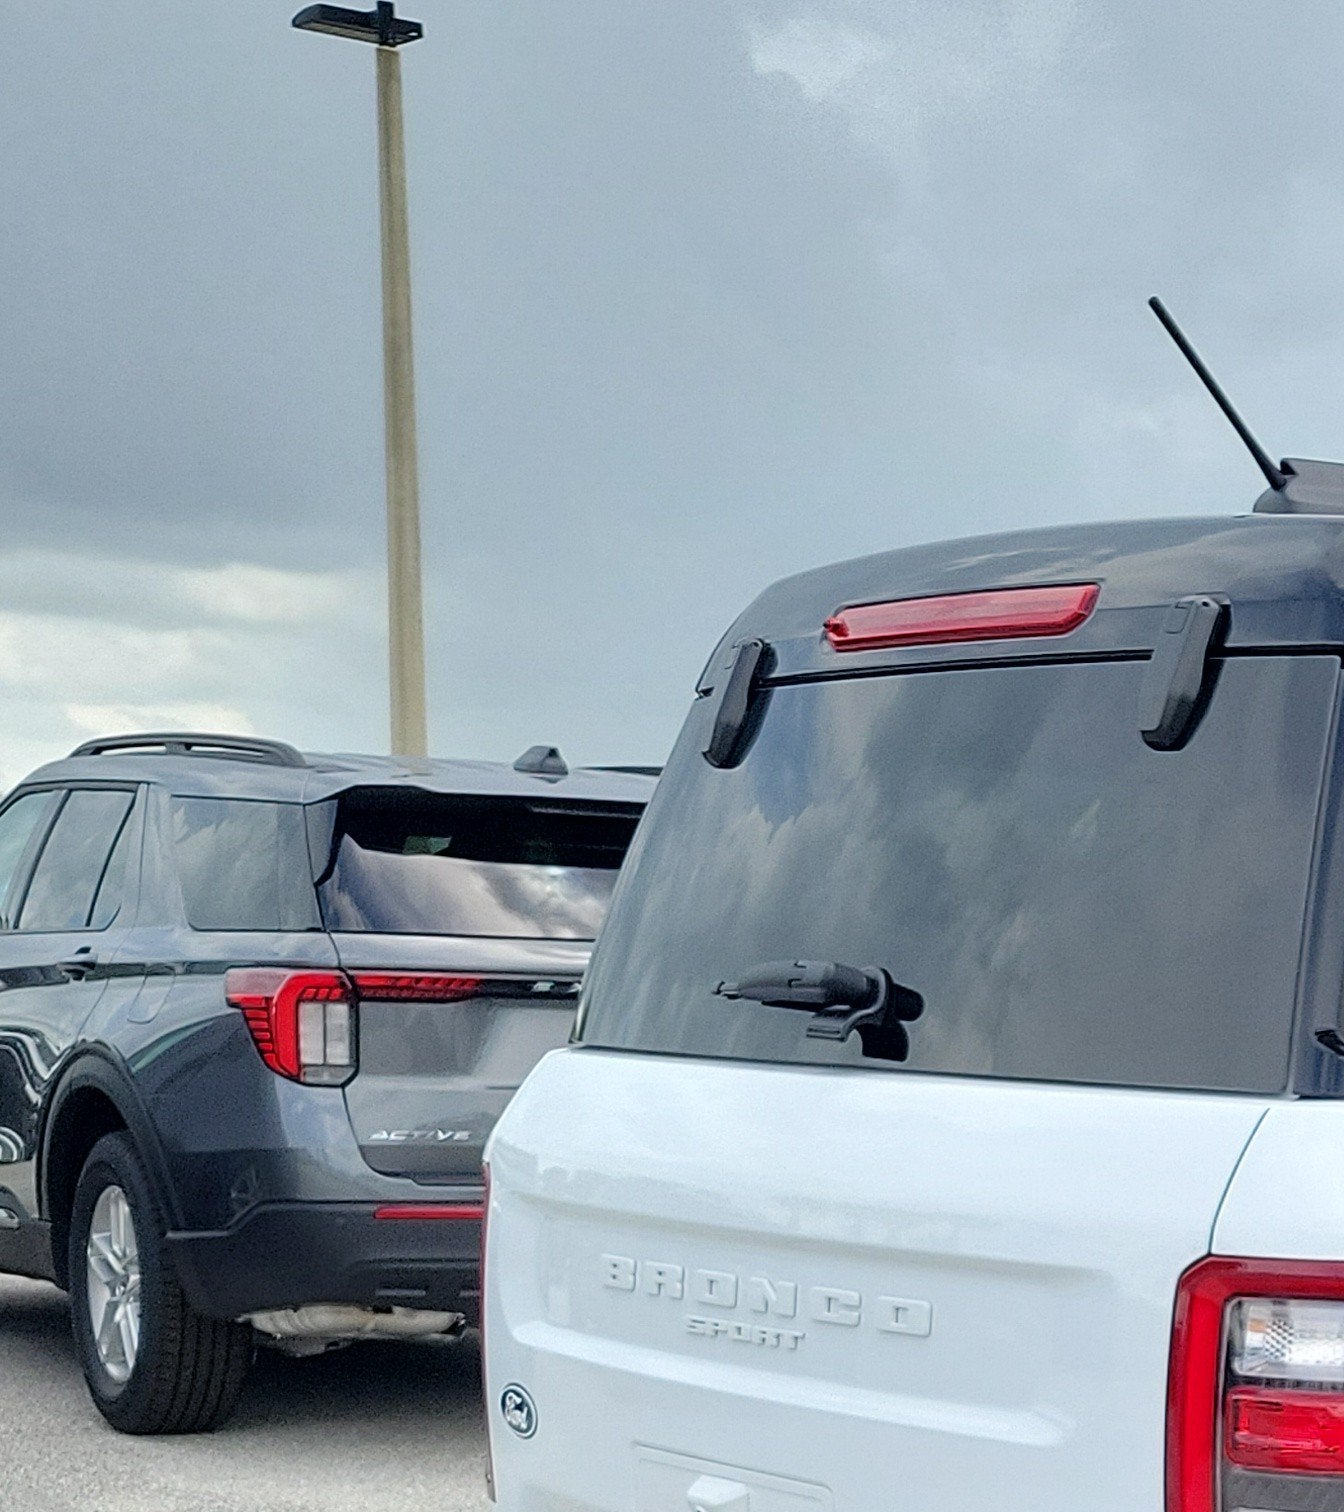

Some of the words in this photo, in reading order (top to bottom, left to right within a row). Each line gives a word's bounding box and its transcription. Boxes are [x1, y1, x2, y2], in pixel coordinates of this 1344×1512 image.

[368, 1127, 472, 1142] ACTIVE
[600, 1252, 933, 1338] BRONCO
[685, 1314, 807, 1350] SPORT
